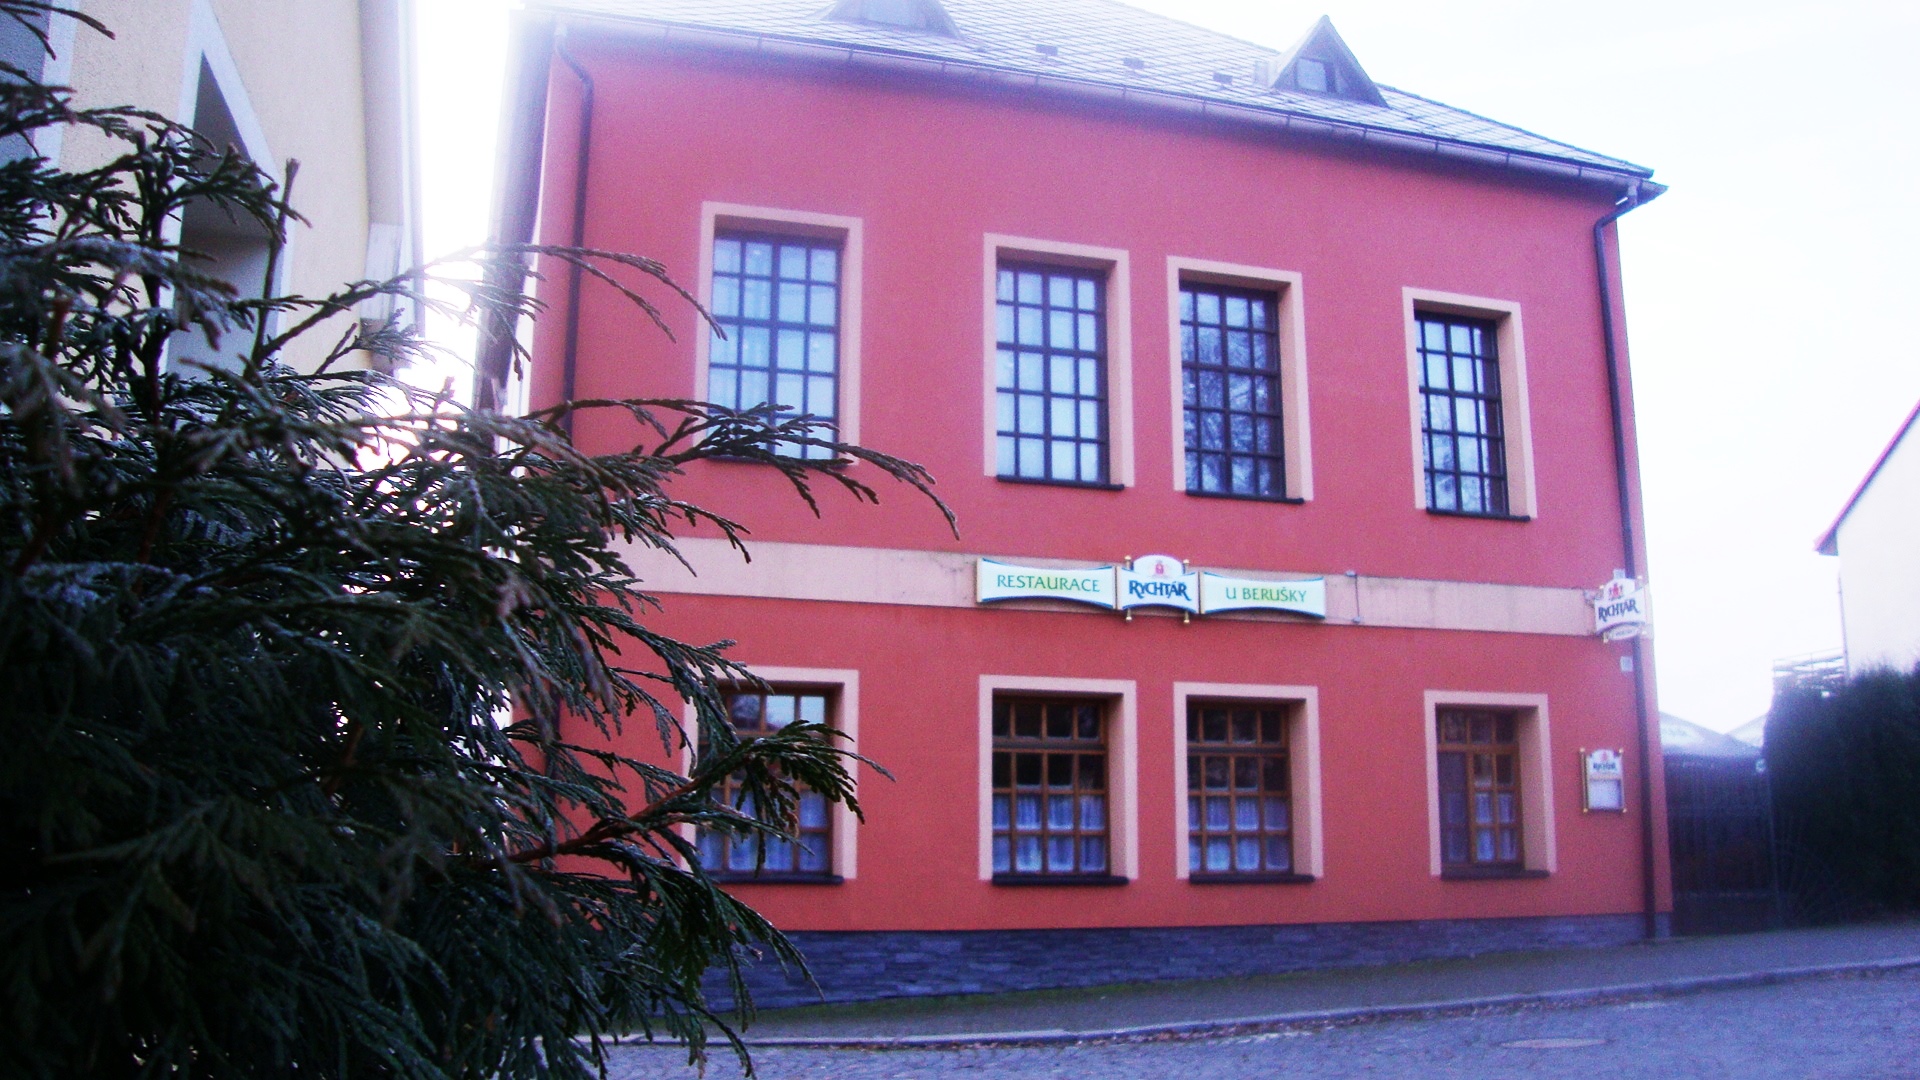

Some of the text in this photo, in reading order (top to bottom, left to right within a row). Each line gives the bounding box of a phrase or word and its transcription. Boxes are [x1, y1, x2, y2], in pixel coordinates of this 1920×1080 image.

[997, 574, 1100, 592] RESTAURACE
[1225, 587, 1307, 602] U BERUŠKY
